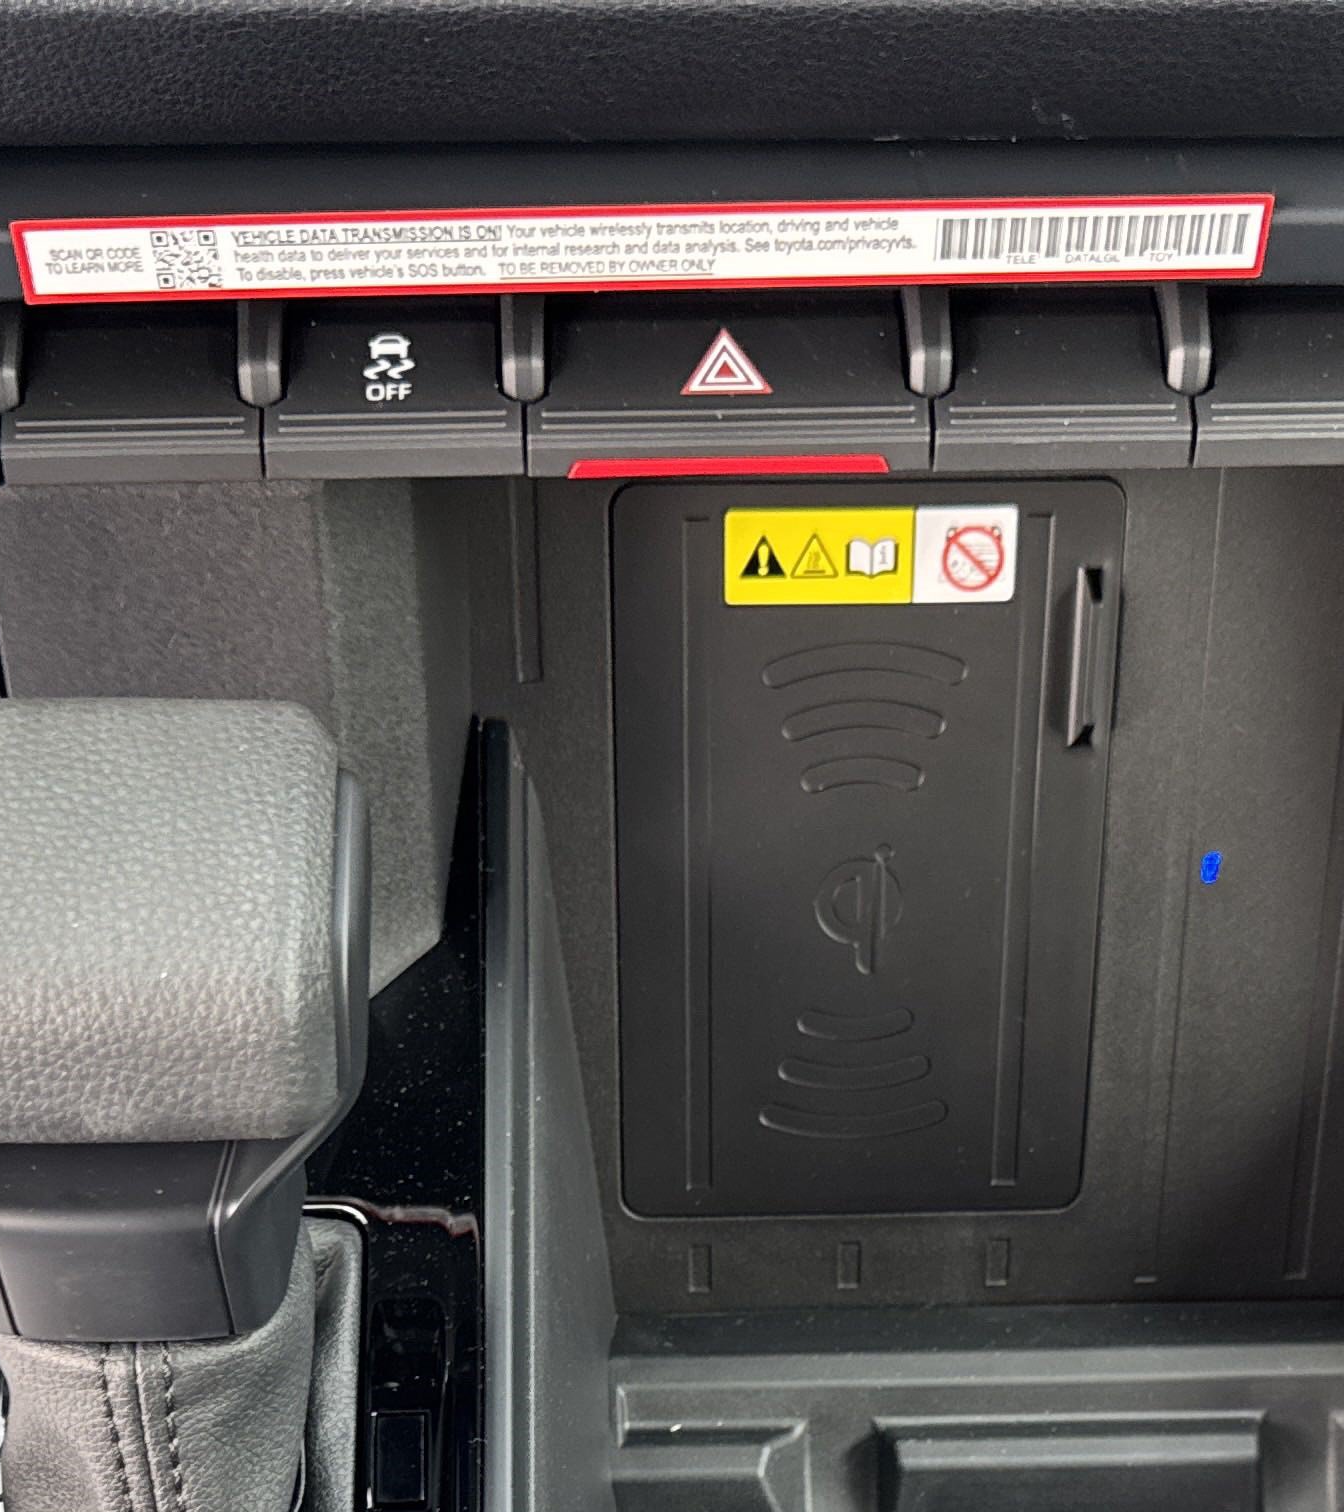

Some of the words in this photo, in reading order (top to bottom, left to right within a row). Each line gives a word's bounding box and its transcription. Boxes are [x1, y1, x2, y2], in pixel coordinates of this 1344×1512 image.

[231, 229, 296, 244] VEHICLE
[299, 228, 338, 243] DATA
[341, 226, 453, 242] TRANSMISSION
[506, 224, 536, 238] Your
[540, 223, 585, 238] vehicle
[589, 222, 652, 239] wirelessly
[656, 220, 715, 235] transmits
[777, 218, 820, 235] driving
[824, 217, 849, 232] and
[853, 217, 899, 231] vehicle
[233, 250, 274, 263] health
[278, 249, 306, 262] data
[327, 248, 370, 261] deliver
[374, 249, 402, 263] your
[406, 248, 460, 259] services
[464, 245, 487, 258] and
[491, 244, 509, 257] for
[512, 242, 560, 257] internal
[564, 241, 620, 256] research
[624, 241, 648, 255] and
[652, 240, 680, 254] data
[744, 237, 770, 253] See
[309, 268, 345, 282] press
[349, 264, 404, 279] vehicle's
[408, 263, 438, 278] SOS
[366, 383, 412, 402] OFF
